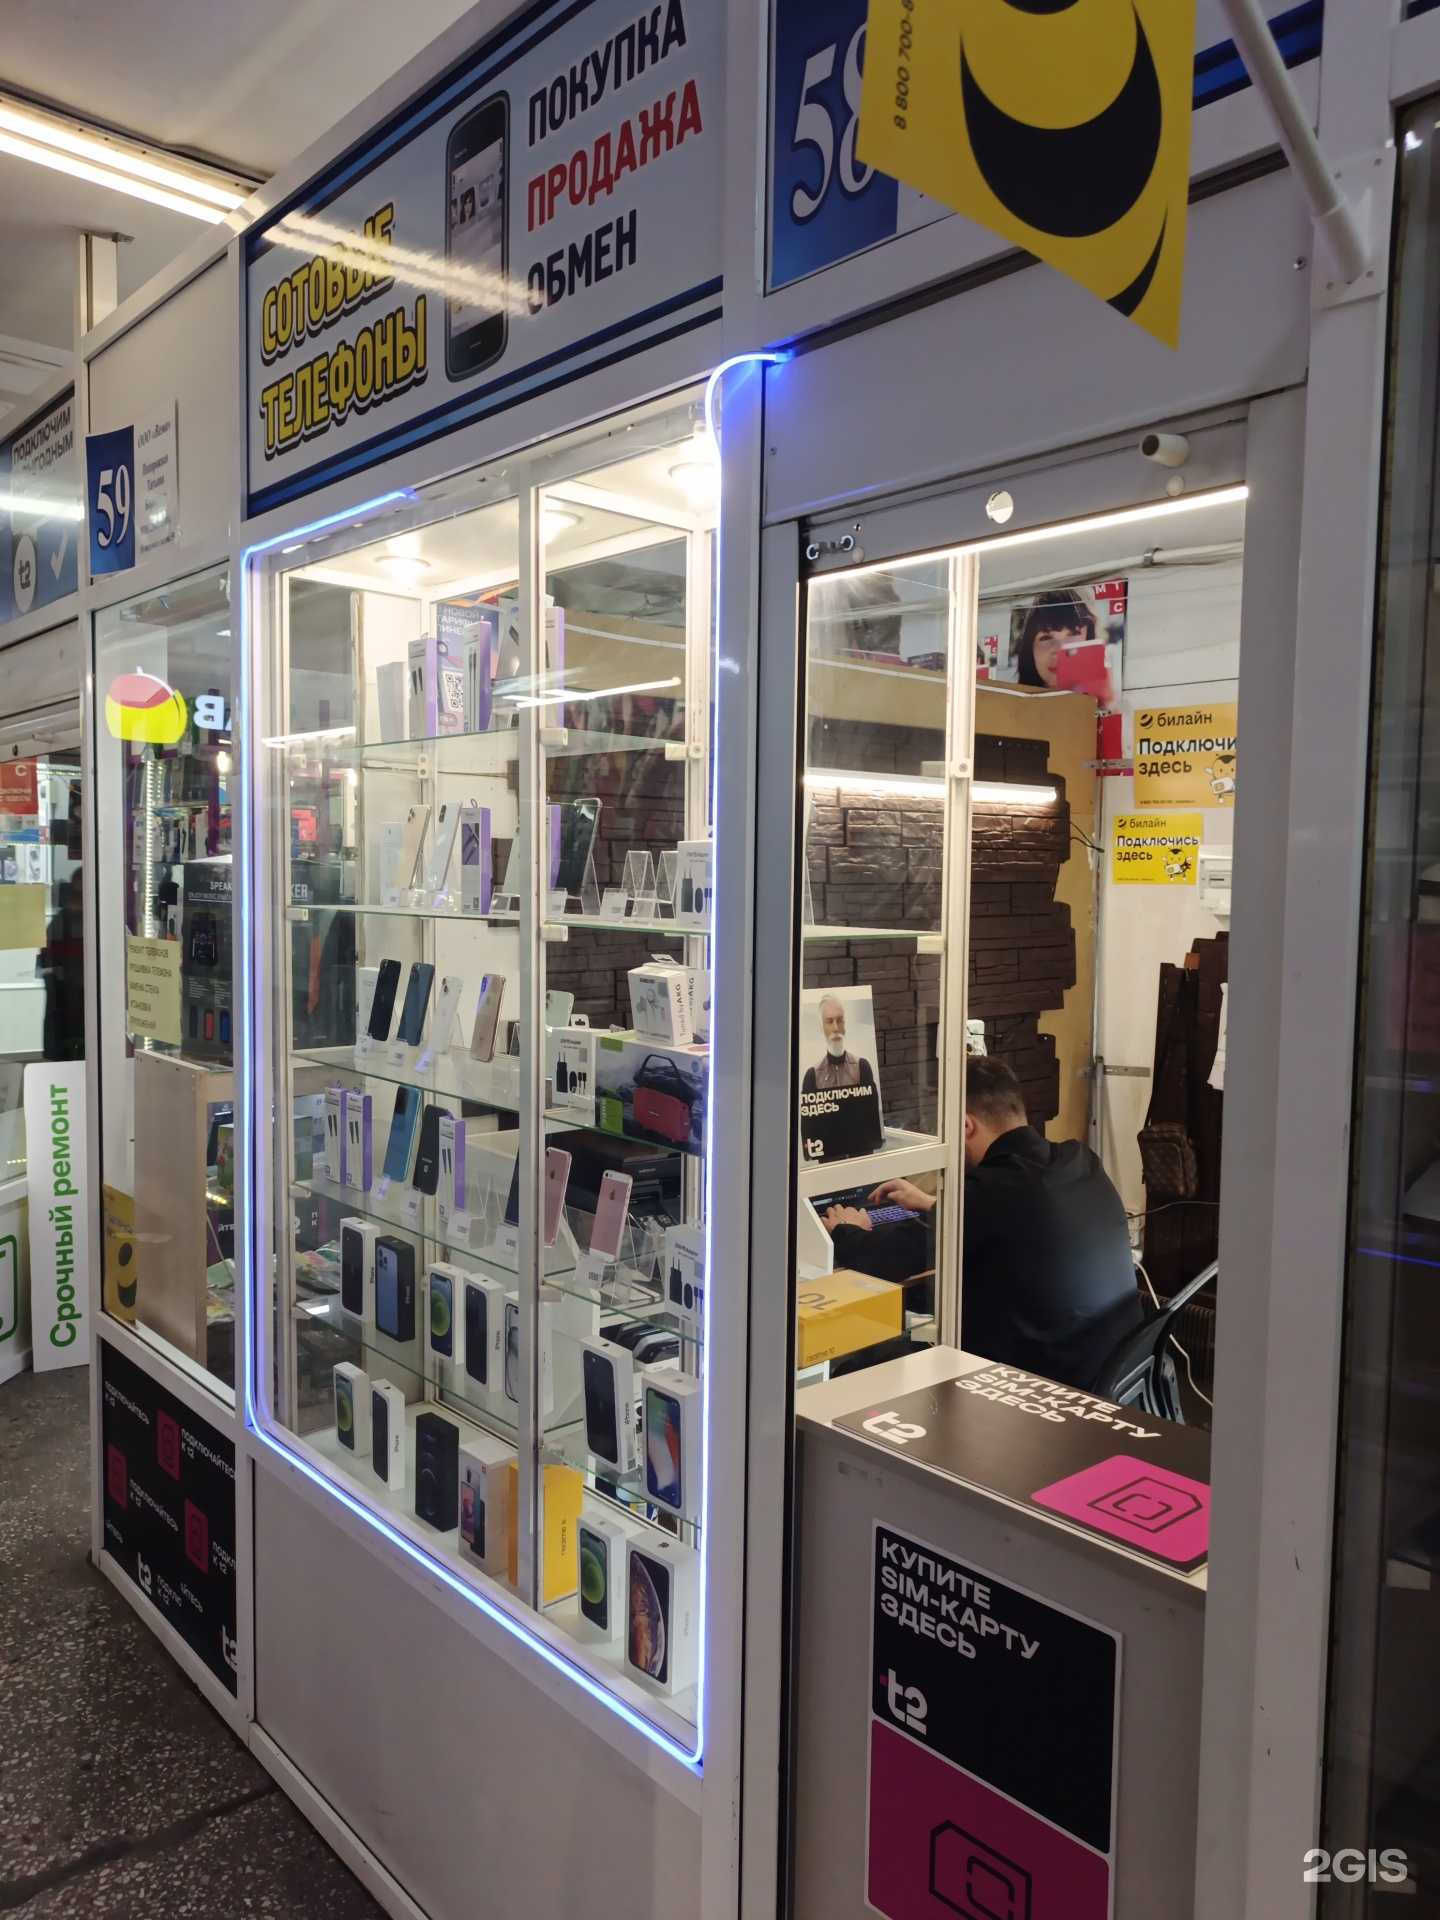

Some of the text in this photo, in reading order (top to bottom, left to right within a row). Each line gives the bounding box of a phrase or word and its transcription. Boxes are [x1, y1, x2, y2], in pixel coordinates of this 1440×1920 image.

[527, 0, 687, 147] ПОКУПКА
[896, 66, 910, 111] 800
[894, 115, 907, 130] 8
[527, 80, 702, 232] ПРОДАЖА
[261, 203, 395, 366] СОТОВЫЕ
[527, 210, 638, 315] ОБМЕН
[260, 296, 429, 460] ТЕЛЕФОНЫ
[14, 406, 71, 465] ПОДКЛЮЧИМ
[97, 464, 130, 547] 59
[1157, 711, 1213, 728] билайн
[1138, 736, 1236, 756] Подключи
[1138, 760, 1192, 776] здесь
[1117, 835, 1199, 849] Подключись
[1130, 817, 1167, 828] билайн
[1117, 850, 1153, 861] здесь
[800, 1086, 873, 1105] ПОДКЛЮЧИМ
[801, 1103, 840, 1117] ЗДЕСЬ
[805, 1138, 825, 1158] t2
[49, 1084, 82, 1347] Срочный ремонт
[954, 1380, 1067, 1422] ЗДЕСЬ
[973, 1374, 1162, 1439] SIM-КАРТУ
[989, 1367, 1122, 1414] КУПИТЕ
[862, 1410, 927, 1446] t2
[181, 1427, 235, 1479] ПОДКЛЮЧАЙТЕС
[882, 1537, 991, 1610] КУПИТЕ
[881, 1565, 1041, 1660] SIM-КАРТУ
[881, 1592, 976, 1660] ЗДЕСЬ
[887, 1668, 928, 1735] t2
